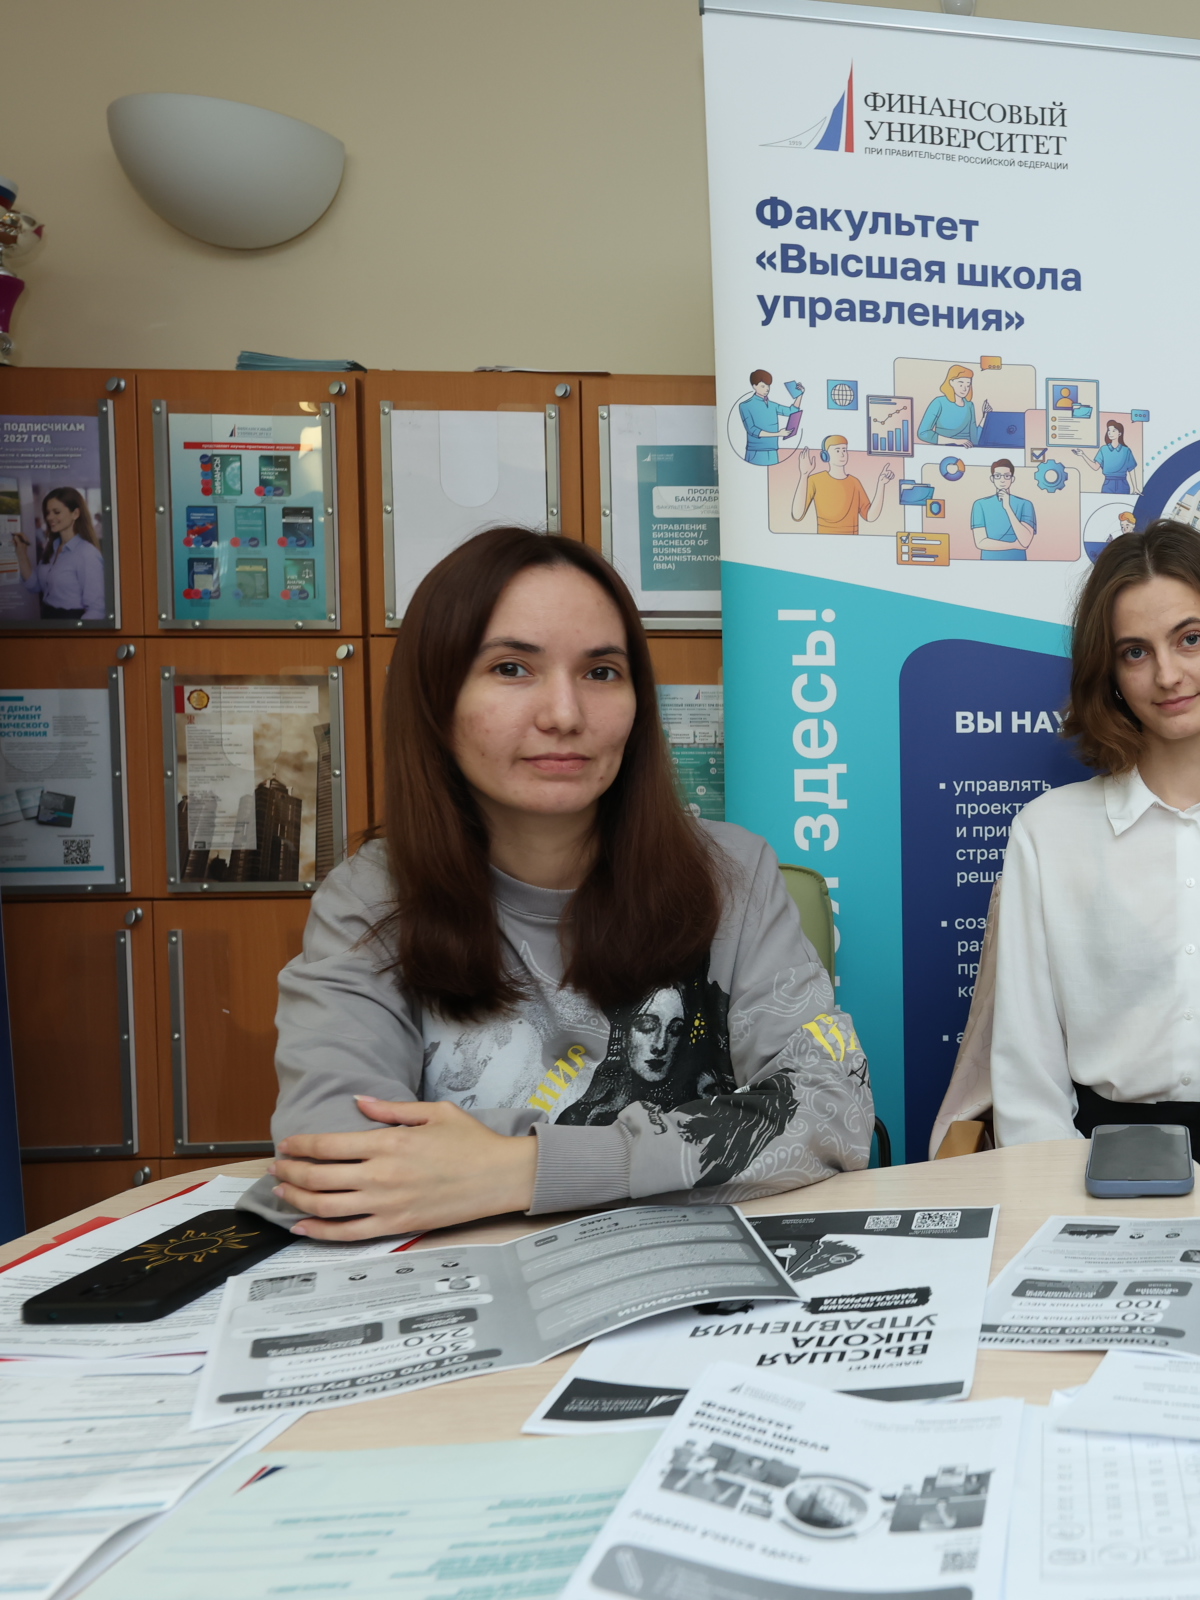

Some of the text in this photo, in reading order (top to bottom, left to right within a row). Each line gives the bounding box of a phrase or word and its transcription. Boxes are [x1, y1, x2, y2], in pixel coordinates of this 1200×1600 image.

[864, 91, 1067, 127] ФИНАНСОВЫЙ
[864, 120, 1067, 156] УНИВЕРСИТЕТ
[864, 147, 1068, 170] ПРИ ПРАВИТЕЛЬСТВЕ РОССИЙСКОЙ ФЕДЕРАЦИИ
[755, 196, 979, 242] Факультет
[755, 243, 1082, 292] «Высшая школа
[756, 294, 1025, 331] управления»
[3, 422, 85, 433] ПОДПИСЧИКАМ
[31, 434, 52, 444] ГОД
[651, 523, 707, 531] УПРАВЛЕНИЕ
[7, 705, 42, 713] ДЕНЬГИ
[777, 608, 848, 851] здесь!
[955, 711, 1070, 733] ВЫ НАУ
[953, 780, 1052, 797] управлять
[956, 826, 1012, 841] и при
[956, 849, 1007, 864] страт
[957, 872, 1003, 887] реше
[954, 917, 987, 930] соз
[617, 1289, 710, 1317] ПРОФИЛИ
[1115, 1299, 1164, 1309] 100
[689, 1314, 938, 1338] УПРАВЛЕНИЯ
[1121, 1312, 1158, 1323] 20
[403, 1327, 469, 1347] 240
[996, 1325, 1156, 1335] ОТ 640 000 РУБЛЕЙ
[792, 1330, 933, 1349] ШКОЛА
[979, 1336, 1169, 1348] СТОИМОСТЬ ОБУЧЕНИ
[425, 1340, 471, 1357] 30
[755, 1344, 929, 1367] ВЫСШАЯ
[443, 1354, 469, 1367] ОТ
[355, 1371, 396, 1385] 000
[234, 1362, 494, 1414] СТОИМОСТЬ ОБУЧЕНИЯ
[262, 1380, 351, 1399] РУБЛЕЙ
